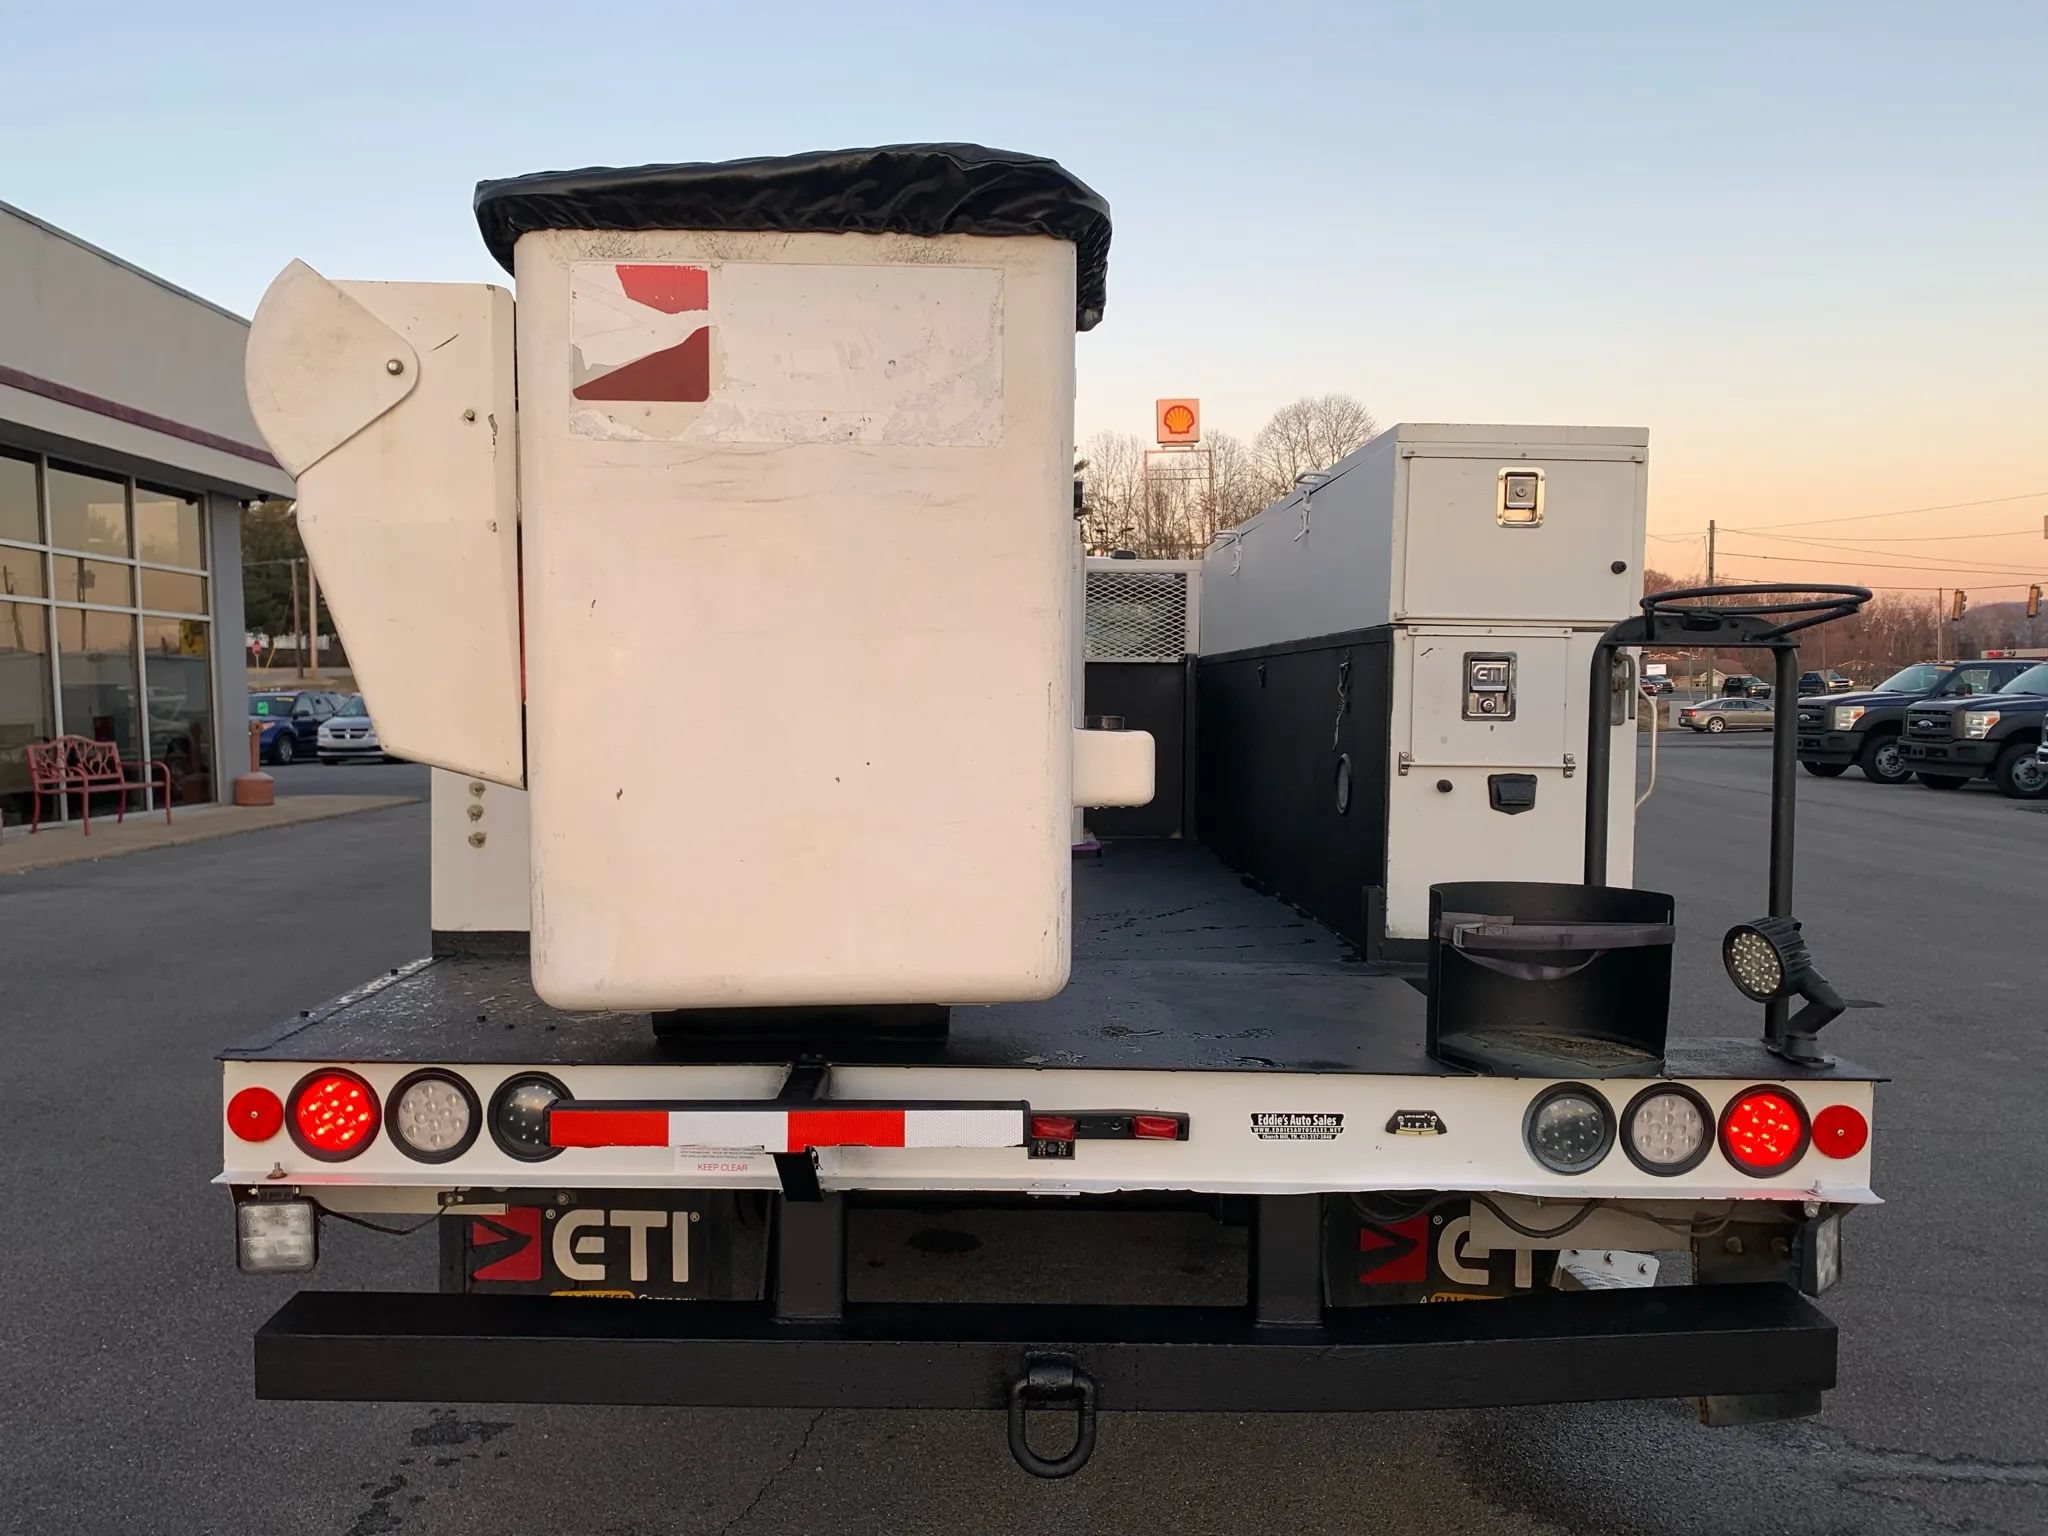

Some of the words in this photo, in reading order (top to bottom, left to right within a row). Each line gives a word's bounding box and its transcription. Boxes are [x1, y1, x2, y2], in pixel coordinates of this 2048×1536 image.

[1258, 1114, 1288, 1126] Eddie's
[1290, 1114, 1311, 1126] Auto
[1312, 1114, 1337, 1126] Sales
[721, 1164, 748, 1172] CLEAR
[552, 1209, 689, 1282] ETI
